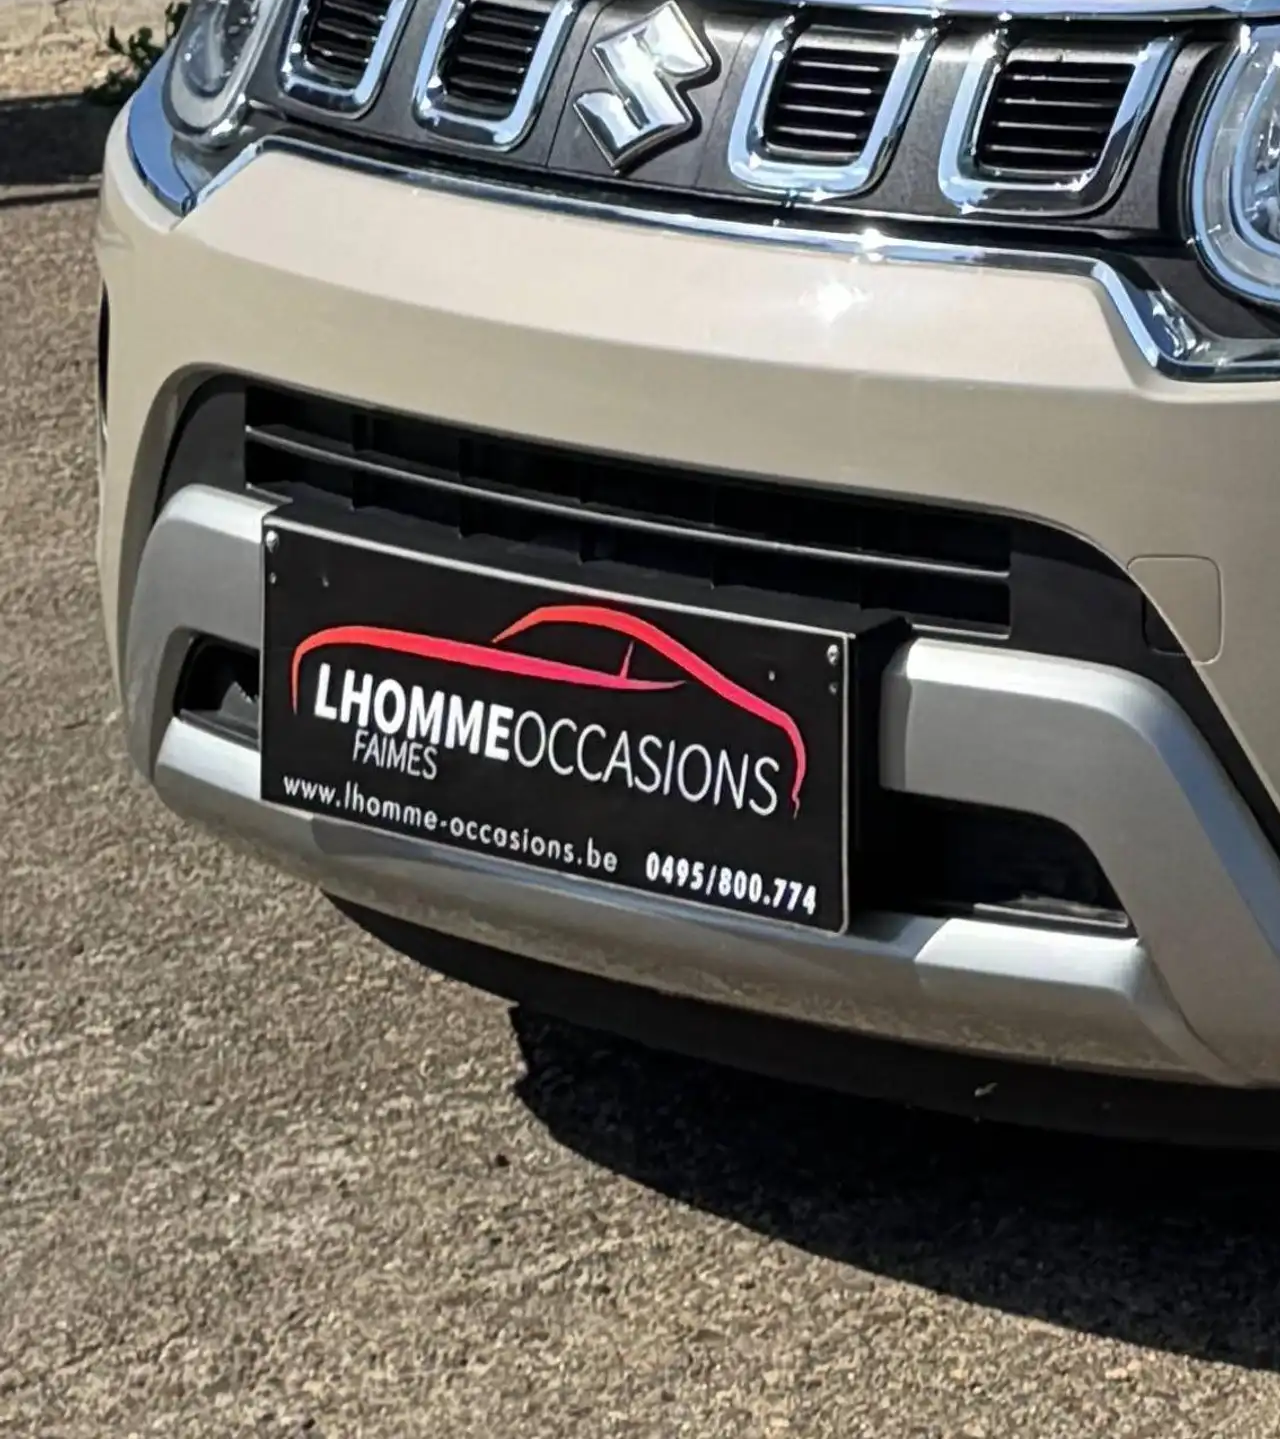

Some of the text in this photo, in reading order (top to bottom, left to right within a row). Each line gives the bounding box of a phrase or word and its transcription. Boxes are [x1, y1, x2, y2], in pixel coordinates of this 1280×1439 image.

[353, 728, 439, 782] FAIMES
[282, 773, 819, 917] www.lhomme-occasions.be 0495/800.774
